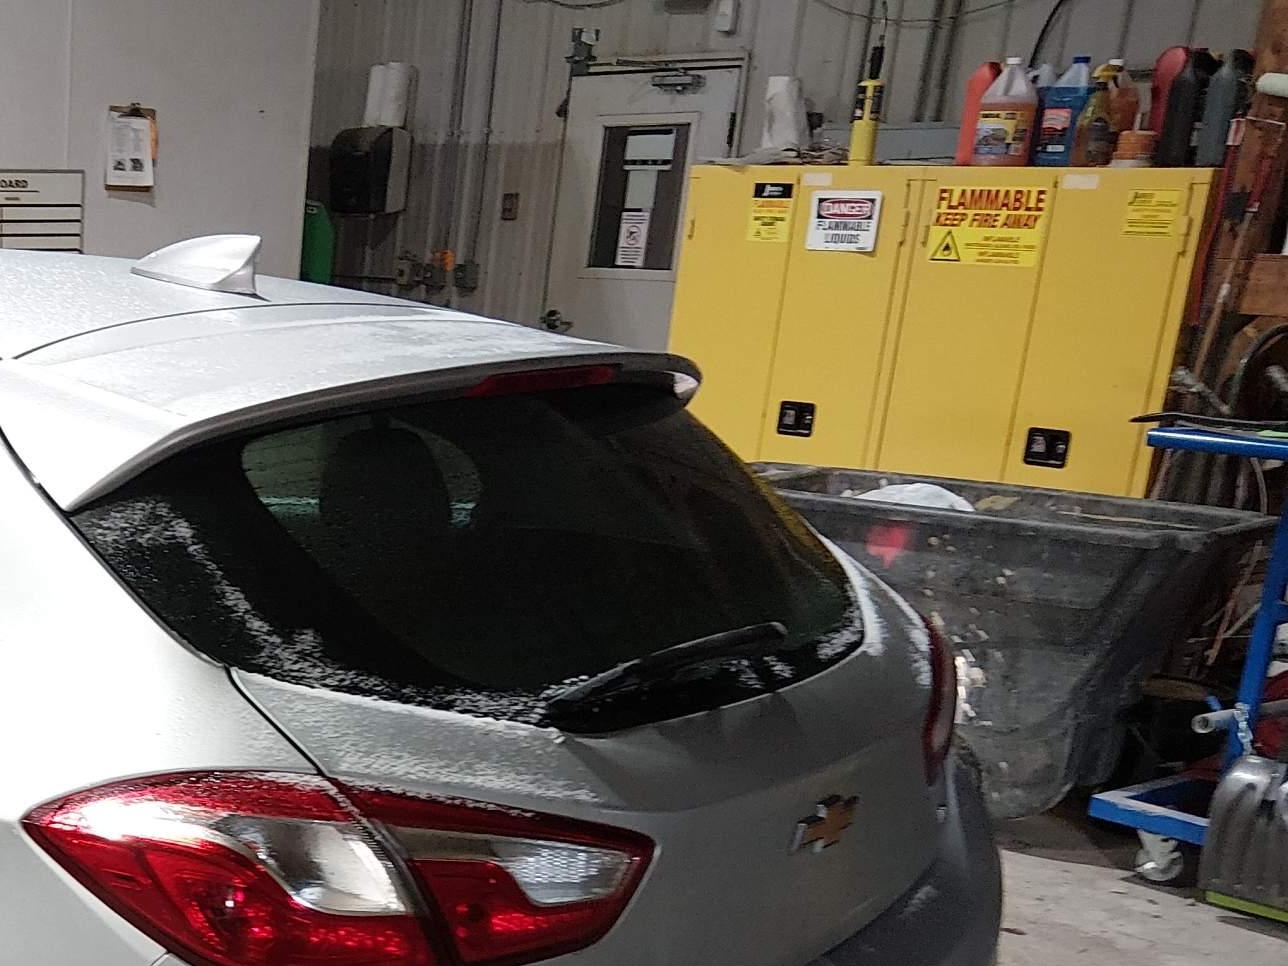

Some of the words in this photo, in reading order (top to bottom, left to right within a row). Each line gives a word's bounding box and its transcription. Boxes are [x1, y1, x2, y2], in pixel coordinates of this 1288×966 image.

[936, 187, 1048, 212] FLAMMABLE
[820, 203, 870, 215] DANGER
[816, 220, 871, 232] FLAMMABLE
[934, 212, 968, 227] KEEP
[968, 213, 1001, 228] FIRE
[1000, 214, 1042, 229] AWAY
[823, 233, 861, 244] LIQUIDS
